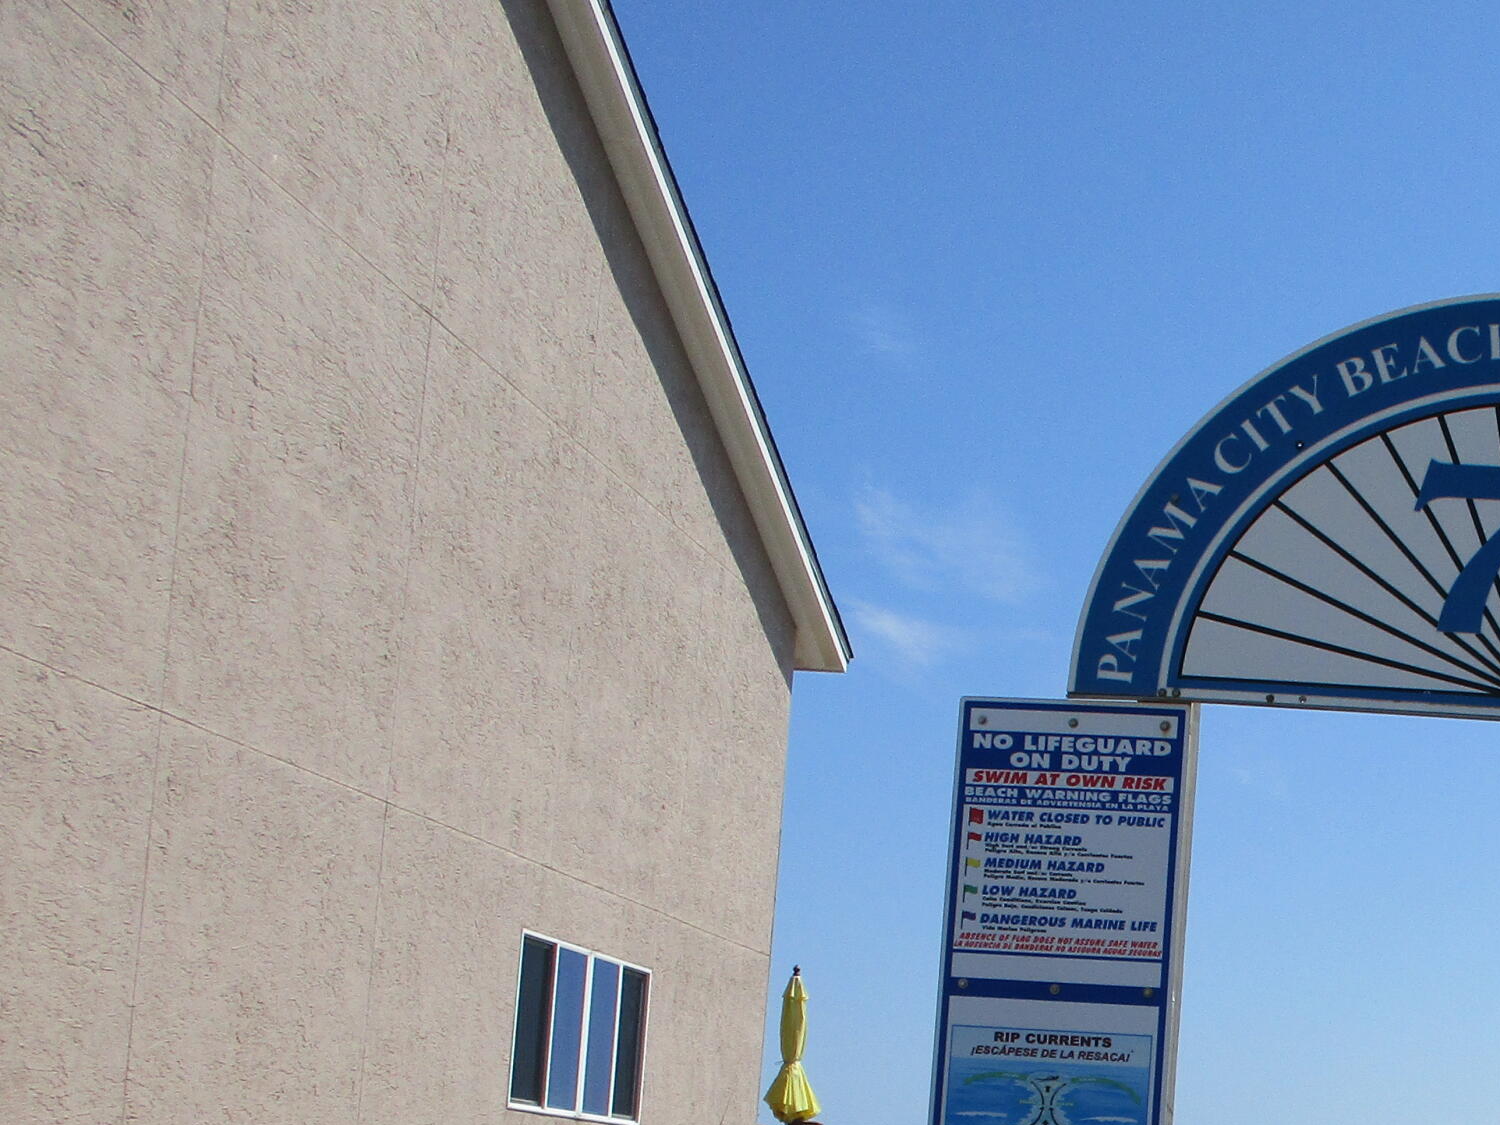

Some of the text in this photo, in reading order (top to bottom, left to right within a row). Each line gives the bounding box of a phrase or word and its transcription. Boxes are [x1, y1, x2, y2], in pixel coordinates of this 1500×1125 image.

[1097, 474, 1223, 684] PANAMA
[1213, 374, 1325, 474] CITY
[973, 733, 1172, 757] NO LIFEGUARD
[1009, 752, 1133, 773] ON DUTY
[972, 770, 1167, 791] SWIM AT OWN RISK
[964, 786, 1171, 805] BEACH WARNING FLAGS
[988, 809, 1165, 828] WATER CLOSED TO PUBLIC
[984, 832, 1082, 846] HIGH HAZARD
[984, 857, 1042, 870] MEDIUM
[1047, 860, 1105, 873] HAZARD
[982, 885, 1077, 900] LOW HAZARD
[980, 913, 1158, 933] DANGEROUS MARINE LIFE
[993, 1031, 1112, 1048] RIP CURRENTS
[1040, 1048, 1057, 1059] DE
[1059, 1049, 1075, 1060] LA
[1077, 1050, 1130, 1063] RESACA!
